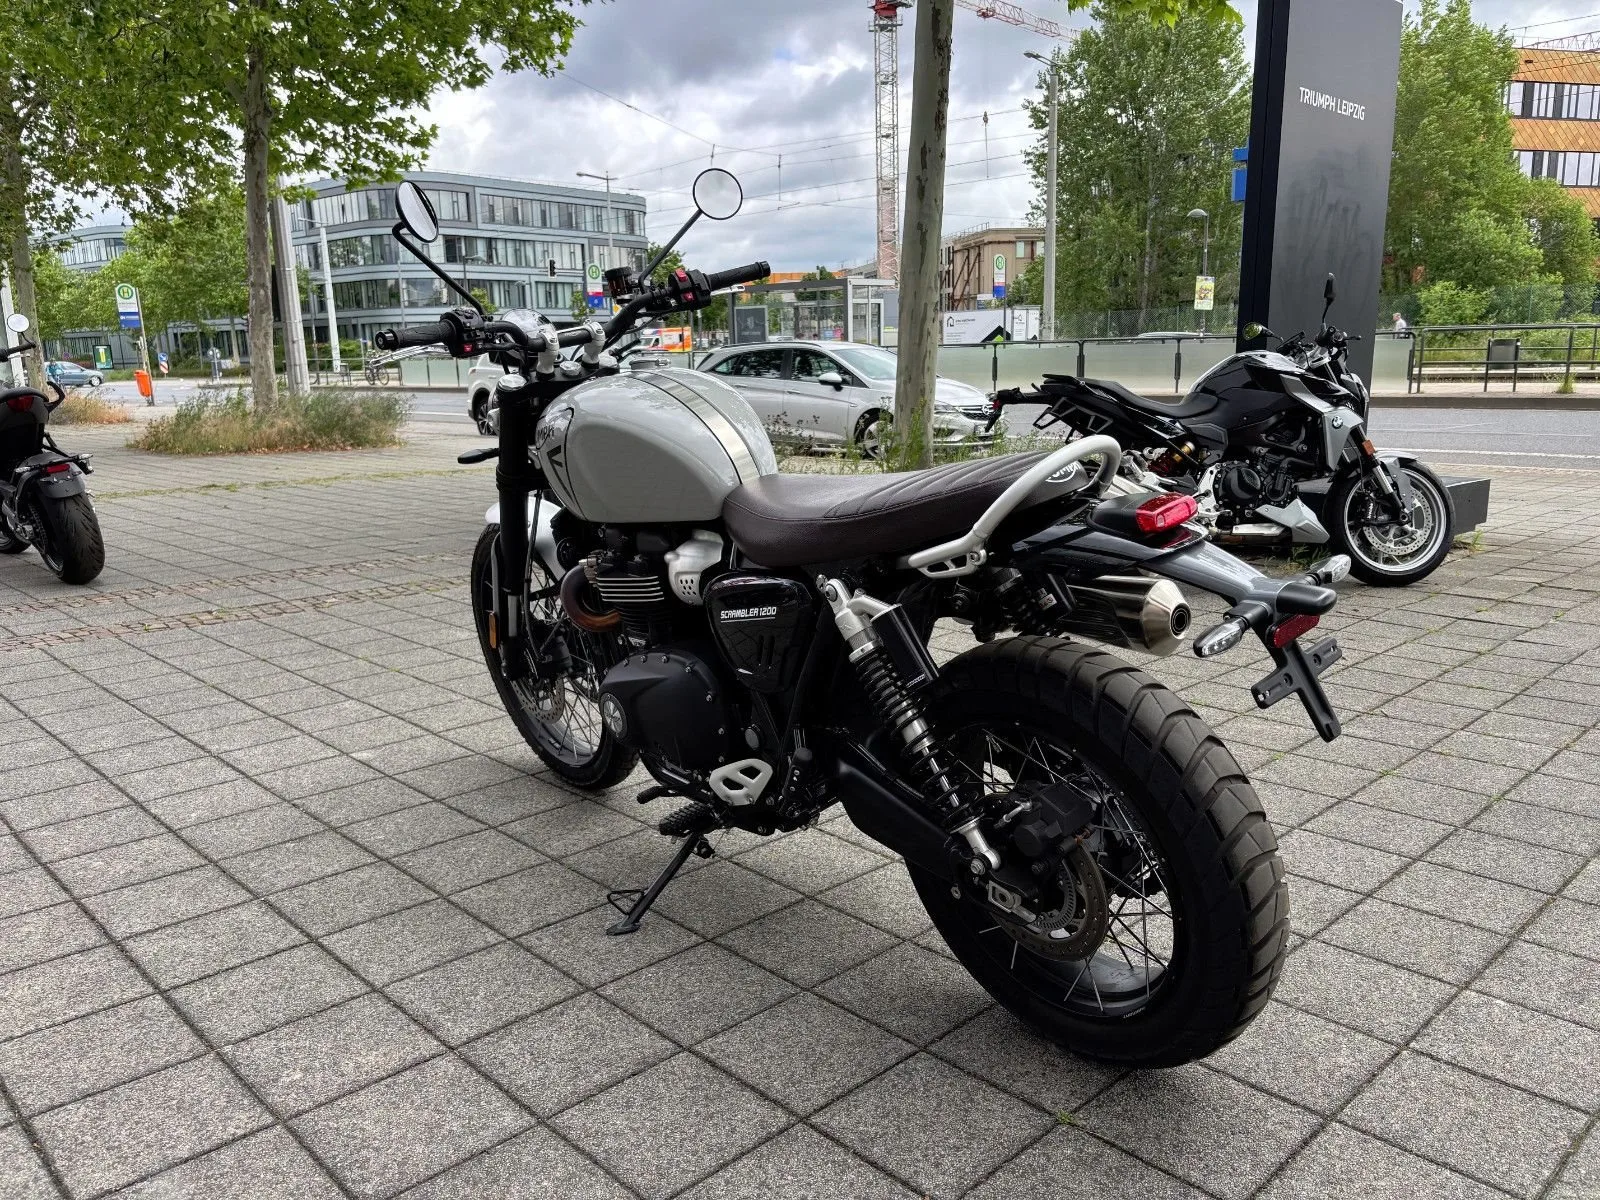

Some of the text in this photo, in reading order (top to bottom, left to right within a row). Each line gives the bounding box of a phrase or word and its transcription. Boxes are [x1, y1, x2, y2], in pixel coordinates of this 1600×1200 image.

[1299, 86, 1366, 121] TRIUMPH LEIPZIG
[720, 606, 777, 619] SCRAMBLER 1200
